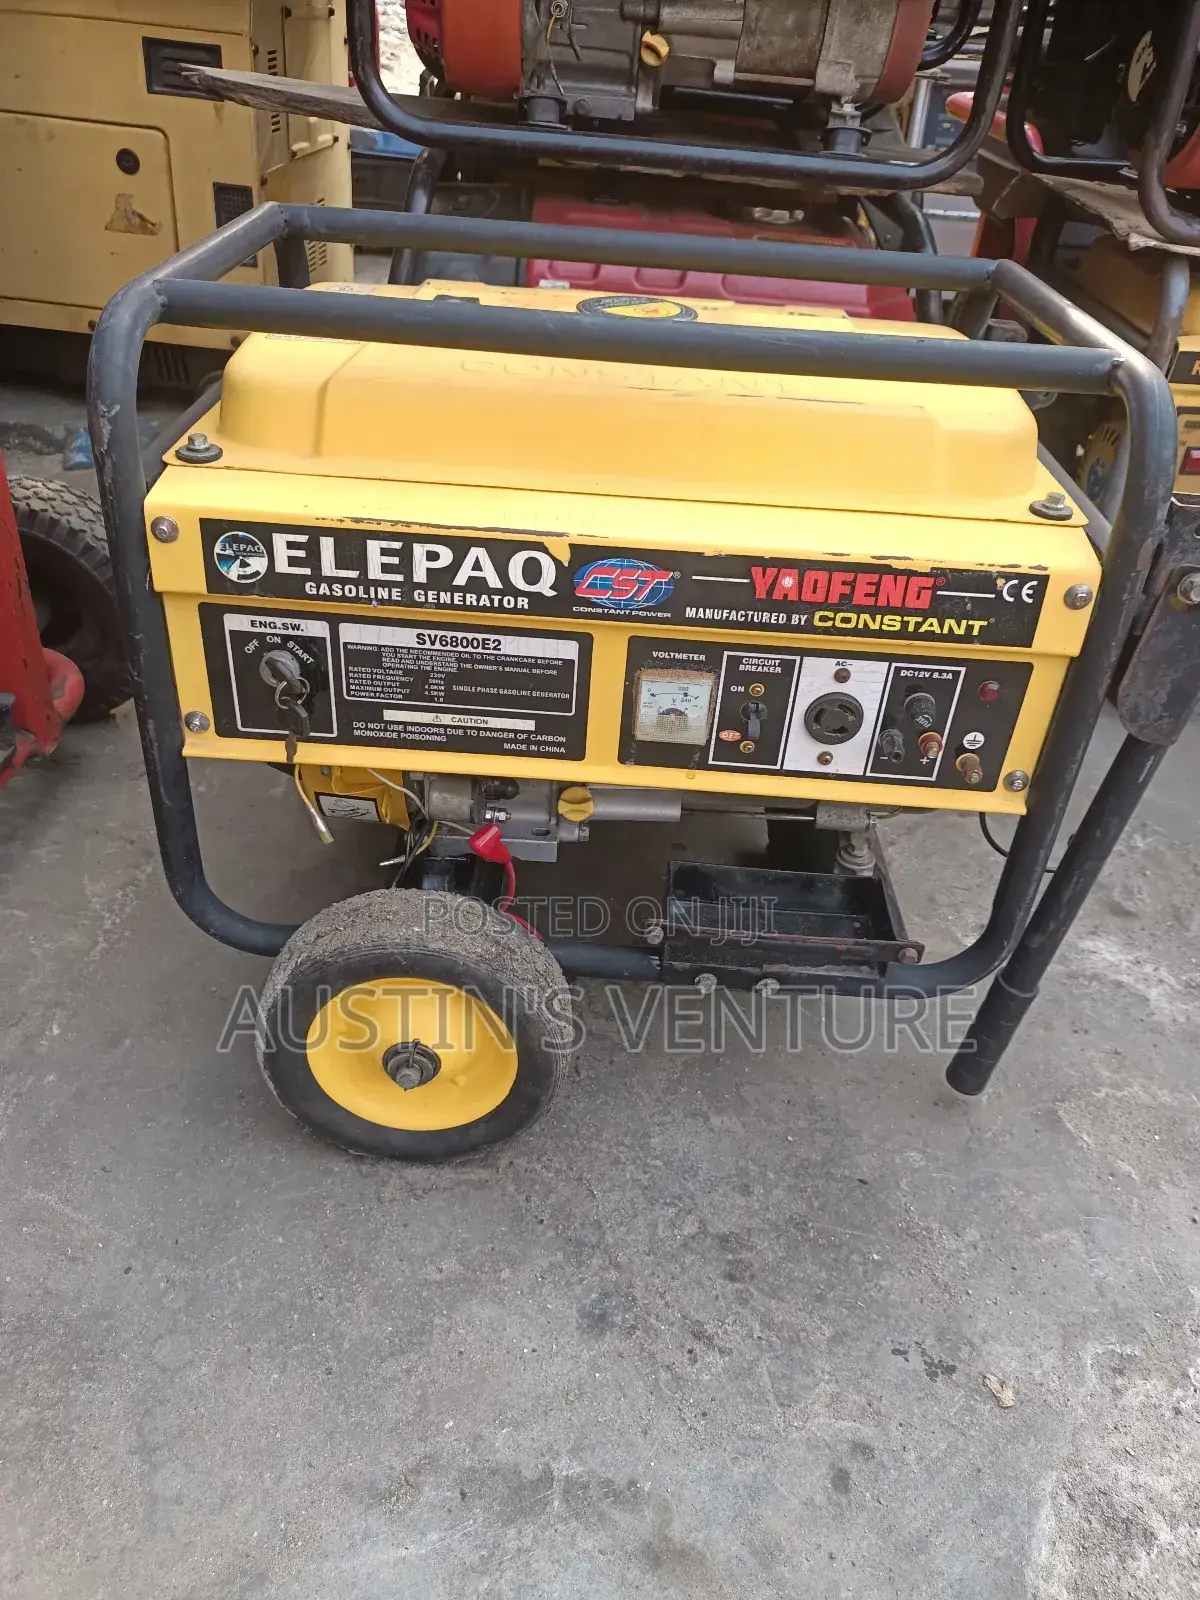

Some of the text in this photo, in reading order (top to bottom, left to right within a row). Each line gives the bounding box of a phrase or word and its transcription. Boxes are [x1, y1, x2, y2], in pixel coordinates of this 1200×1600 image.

[219, 542, 263, 553] ELEPAQ
[272, 532, 558, 597] ELEPAQ
[574, 566, 674, 601] CST
[750, 566, 935, 609] YAOFENG
[304, 581, 529, 610] GASOLINE GENERATOR
[1002, 579, 1038, 604] CE
[572, 606, 671, 618] CONSTANT POWER
[250, 620, 305, 632] ENG.SW.
[685, 607, 988, 636] MANUFACTURED BY CONSTANT
[266, 635, 282, 644] ON
[416, 633, 502, 652] SV6800E2
[244, 639, 260, 654] OFF
[286, 640, 315, 665] START
[347, 644, 380, 652] WARNING:
[409, 648, 460, 658] RECOMMENDED
[496, 656, 536, 664] CRANKCASE
[652, 651, 706, 661] VOLTMETER
[382, 662, 419, 670] OPERATING
[415, 660, 459, 668] UNDERSTAND
[474, 664, 503, 672] OWNER'S
[532, 668, 558, 676] BEFORE
[742, 658, 781, 666] CIRCUIT
[372, 668, 404, 676] VOLTAGE
[739, 664, 782, 674] BREAKER
[900, 670, 953, 680] DC12V 8.3A
[372, 675, 414, 683] FREQUENCY
[452, 684, 476, 692] SINGLE
[499, 689, 532, 697] GASOLINE
[532, 691, 570, 700] GENERATOR
[730, 685, 745, 693] ON
[451, 716, 488, 725] CAUTION
[353, 730, 447, 742] MONOXIDE POISONING
[387, 724, 404, 732] USE
[406, 726, 445, 734] INDOORS
[447, 728, 464, 736] DUE
[466, 729, 478, 737] TO
[480, 730, 515, 739] DANGER
[530, 734, 566, 742] CARBON
[503, 743, 528, 751] MADE
[540, 745, 566, 753] CHINA
